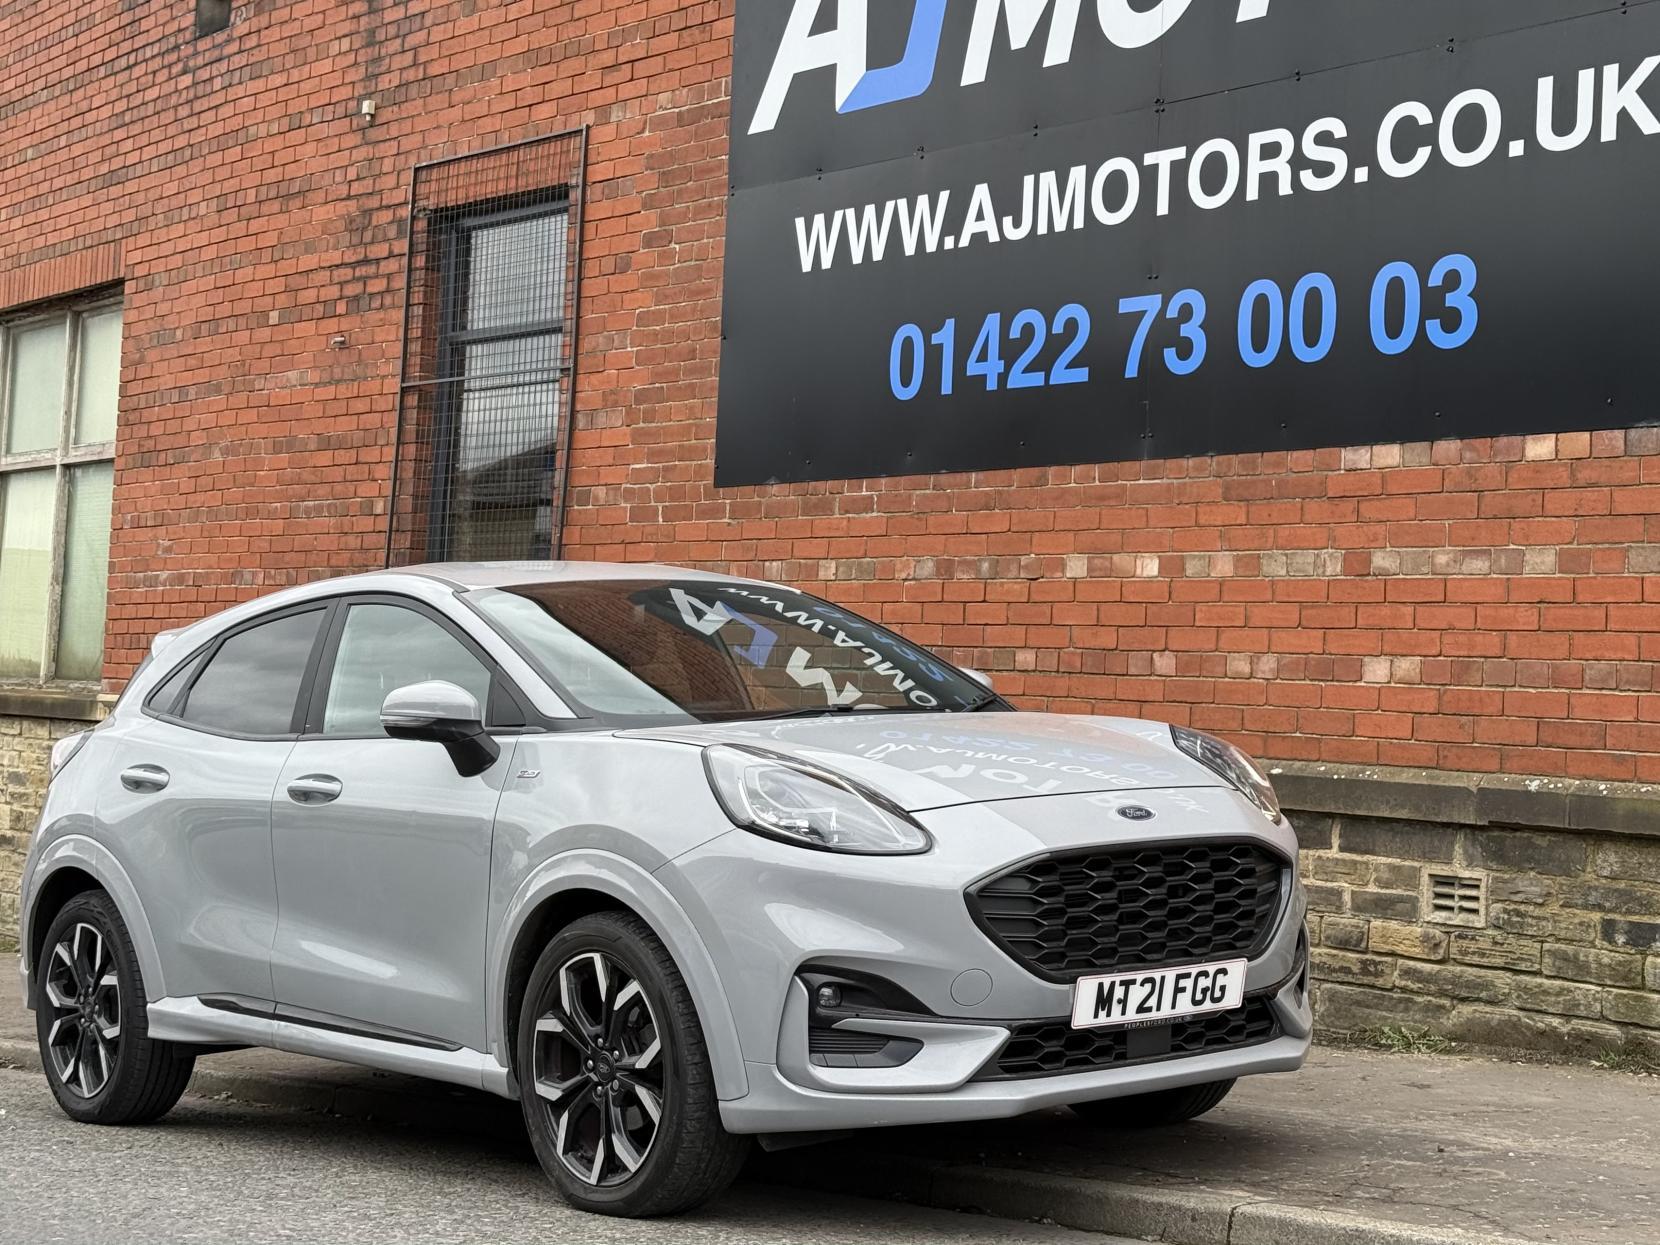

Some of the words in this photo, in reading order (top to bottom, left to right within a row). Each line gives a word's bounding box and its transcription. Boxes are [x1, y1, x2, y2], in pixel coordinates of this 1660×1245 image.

[795, 55, 1660, 272] WWW.AJMOTORS.CO.UK
[890, 304, 1090, 400] 01422
[1119, 289, 1206, 378] 73
[1238, 272, 1336, 367] 00
[1370, 254, 1478, 354] 03
[1093, 975, 1166, 1019] MT21
[1171, 967, 1229, 1010] FGG
